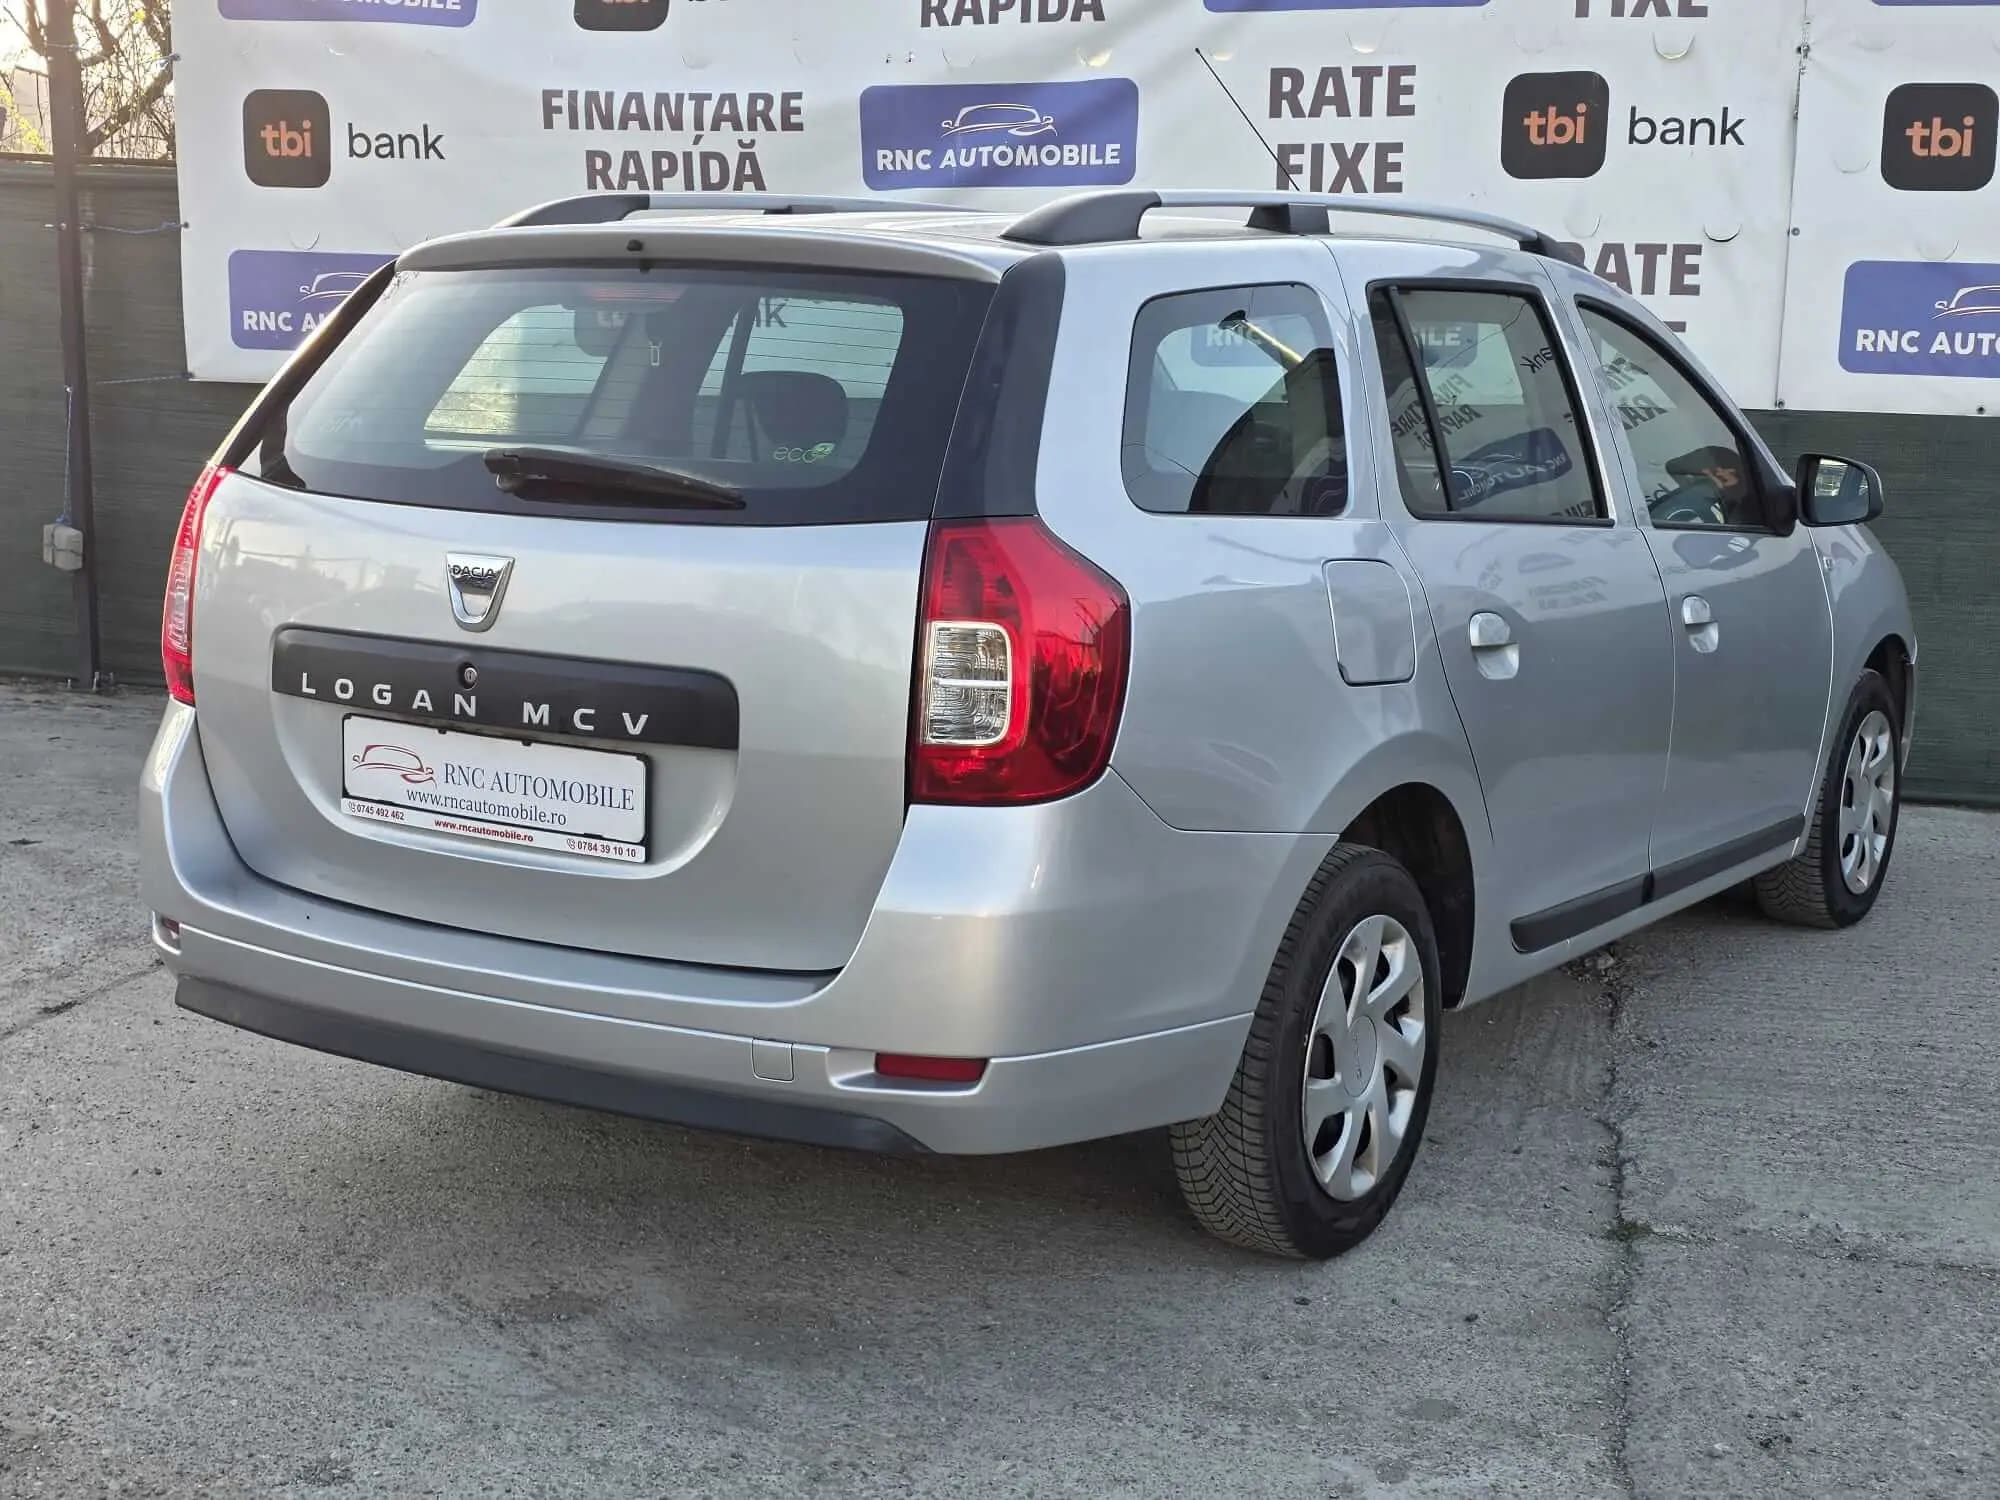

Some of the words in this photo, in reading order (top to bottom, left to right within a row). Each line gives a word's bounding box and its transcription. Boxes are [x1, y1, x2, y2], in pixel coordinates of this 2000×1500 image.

[1268, 65, 1417, 119] RATE
[260, 119, 313, 157] tbi
[347, 123, 446, 160] bank
[1523, 103, 1586, 145] tbi
[1629, 106, 1746, 146] bank
[1905, 115, 1976, 158] tbi
[877, 149, 932, 171] RNC
[939, 143, 1121, 169] AUTOMOBILE
[1275, 142, 1404, 193] FIXE
[243, 310, 293, 332] RNC
[1856, 329, 1921, 353] RNC
[452, 565, 497, 578] DACIA
[301, 671, 477, 718] LOGAN
[522, 701, 649, 736] MCV
[444, 763, 486, 790] RNC
[490, 771, 635, 811] AUTOMOBILE
[357, 803, 374, 816] 0745
[376, 807, 389, 818] 492
[391, 811, 405, 821] 462
[407, 789, 567, 826] www.rncautomobile.ro
[434, 819, 534, 842] www.rncautomobile.ro
[577, 840, 598, 852] 0784
[600, 843, 611, 854] 39
[613, 845, 624, 856] 10
[626, 846, 636, 857] 10
